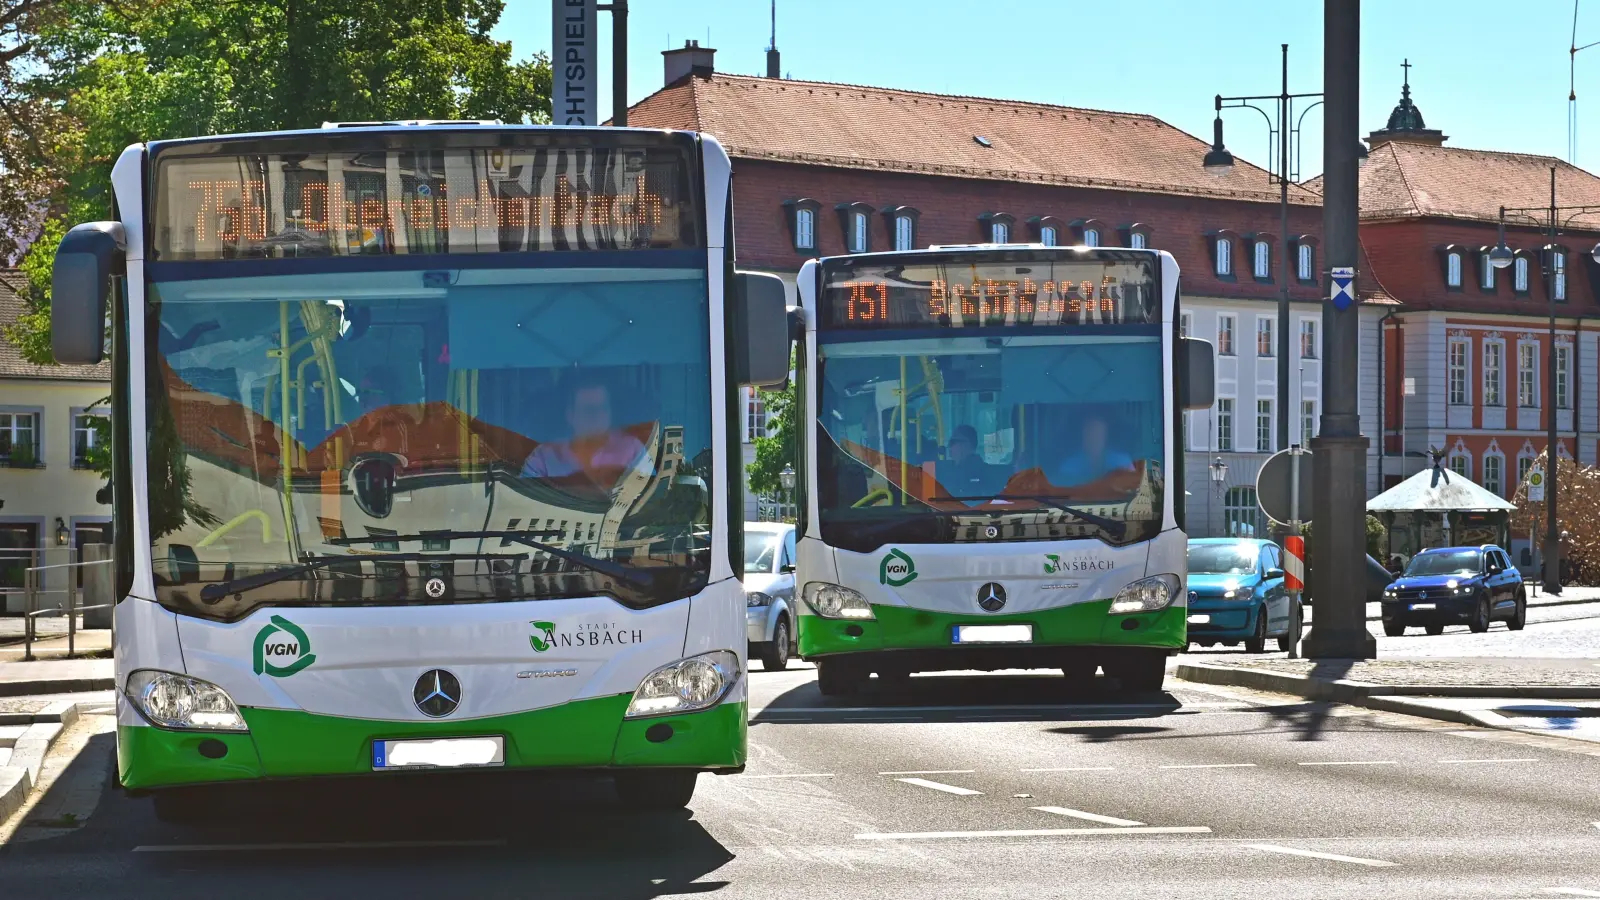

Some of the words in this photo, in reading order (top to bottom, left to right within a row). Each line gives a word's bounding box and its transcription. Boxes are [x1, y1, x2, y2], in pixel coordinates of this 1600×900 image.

[188, 180, 266, 241] 756
[303, 175, 661, 231] Obereichenbach
[843, 281, 887, 320] 751
[929, 296, 1114, 315] Schalkhausen
[887, 565, 907, 573] VGN
[1053, 559, 1114, 571] ANSBACH
[578, 622, 616, 631] STADT
[542, 629, 642, 648] ANSBACH
[265, 643, 298, 656] VGN
[516, 668, 578, 679] CITARO
[376, 756, 382, 764] D
